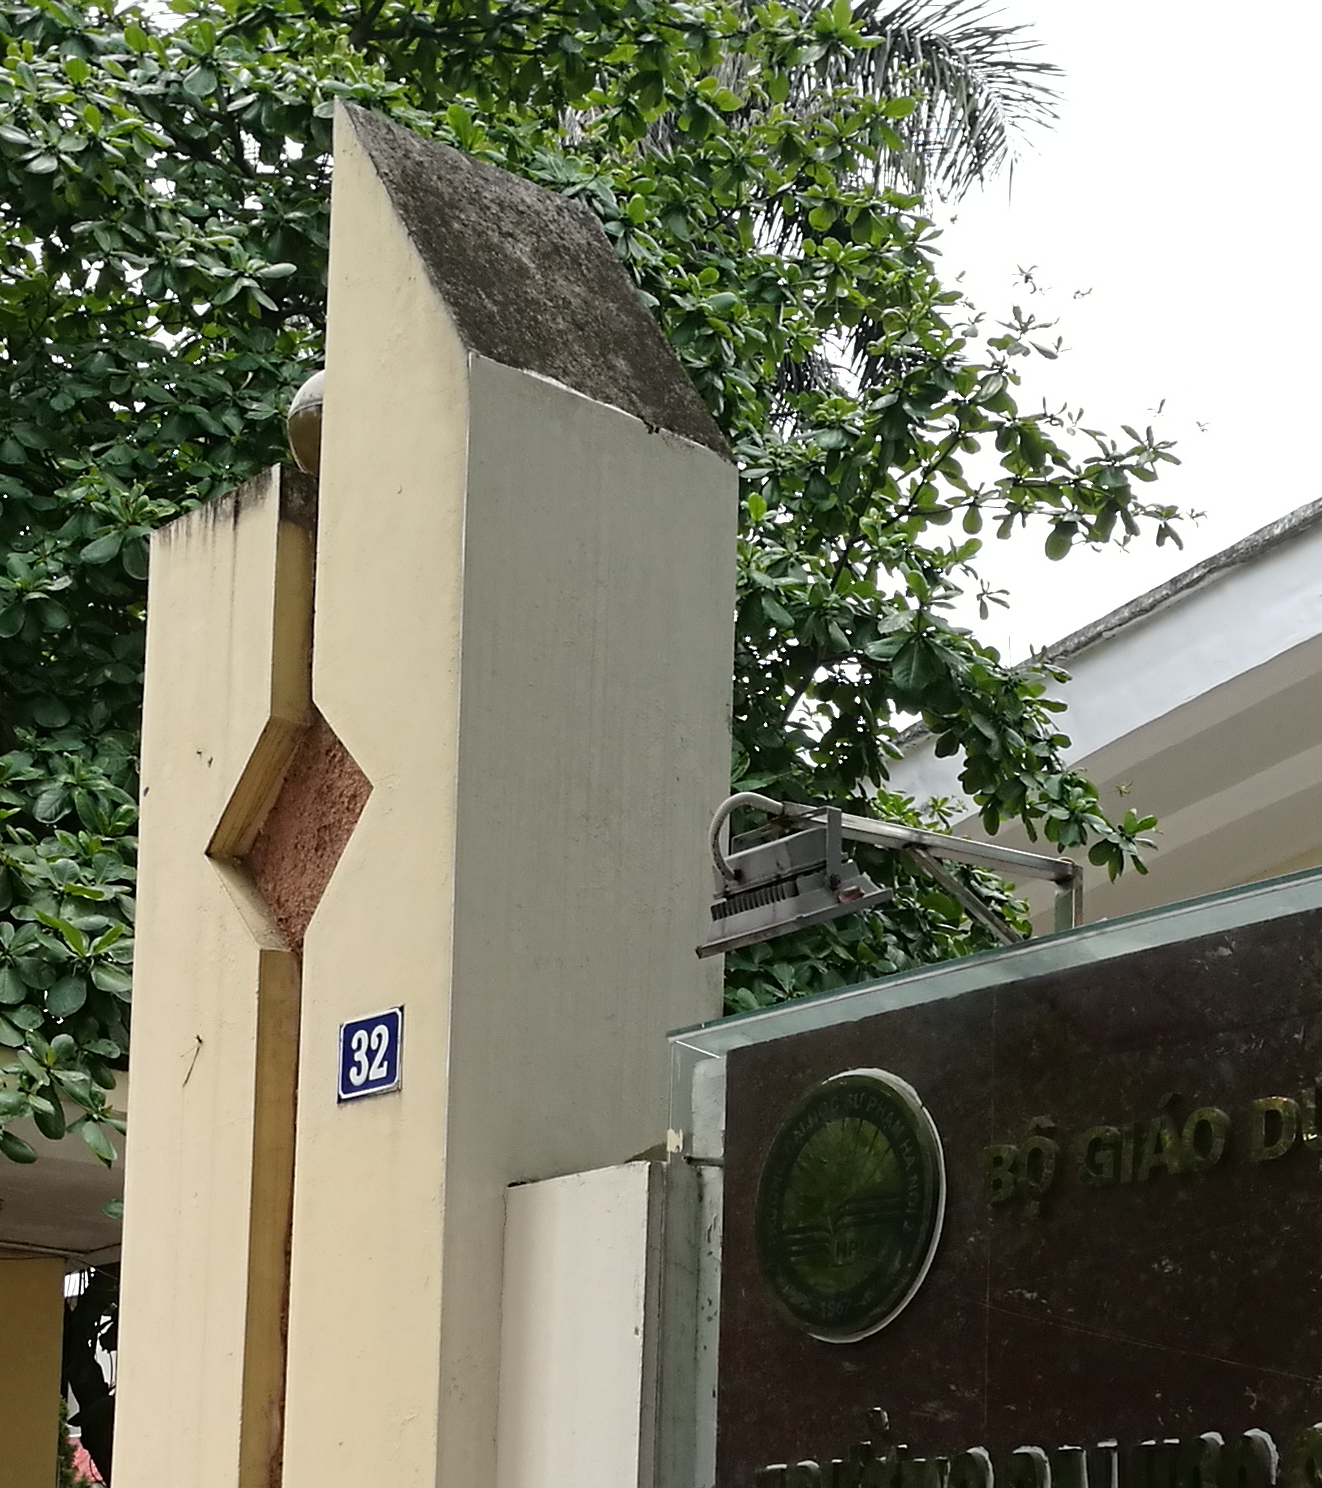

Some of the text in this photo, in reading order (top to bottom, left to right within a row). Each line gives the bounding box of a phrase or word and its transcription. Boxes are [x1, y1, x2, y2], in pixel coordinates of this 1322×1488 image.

[348, 1024, 390, 1087] 32
[982, 1114, 1061, 1219] BỘ
[1077, 1092, 1231, 1190] GIÁO
